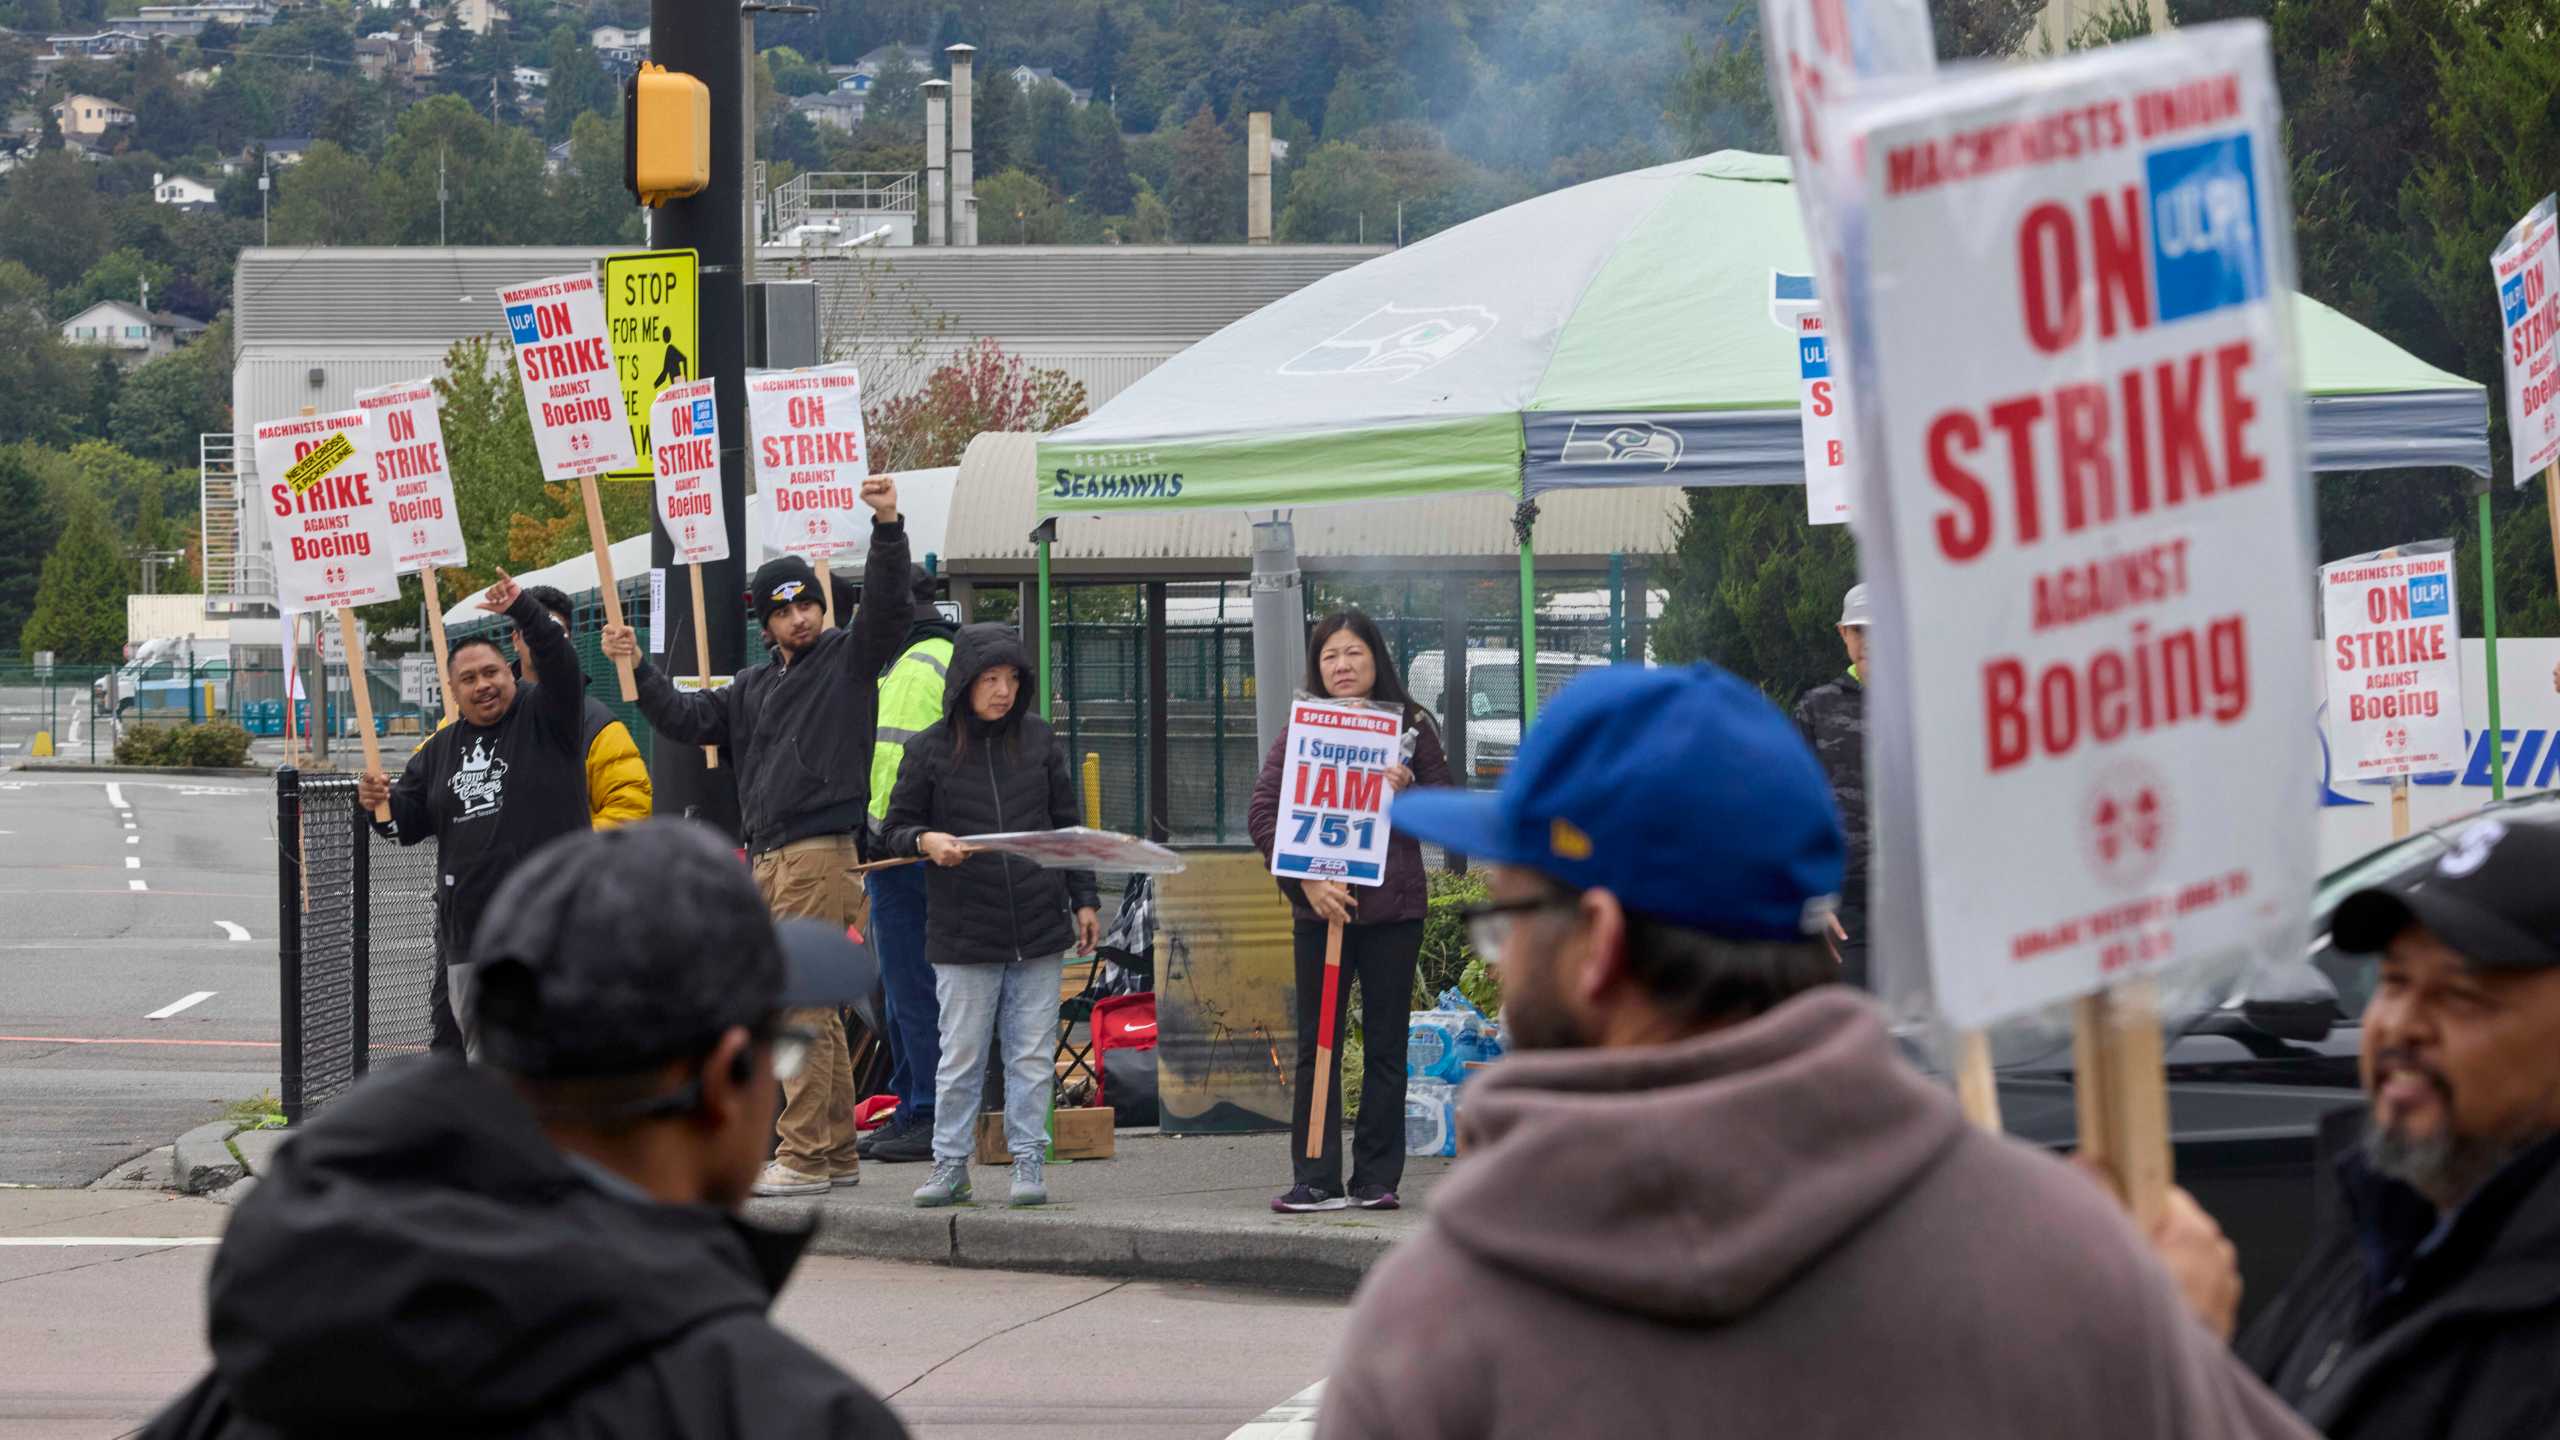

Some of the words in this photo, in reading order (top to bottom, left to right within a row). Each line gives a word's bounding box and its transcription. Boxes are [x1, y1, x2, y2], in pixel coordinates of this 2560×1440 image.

[1886, 96, 2125, 196] MACHINISTS
[2133, 72, 2242, 141] UNION
[2018, 183, 2154, 358] ON
[2525, 260, 2544, 308] ON
[503, 284, 562, 303] MACHINISTS
[563, 278, 593, 293] UNION
[625, 272, 677, 306] STOP
[511, 313, 535, 330] ULP!
[536, 302, 573, 339] ON
[613, 318, 637, 344] FOR
[642, 316, 660, 342] ME
[523, 337, 609, 382] STRIKE
[614, 355, 639, 381] T'S
[549, 380, 590, 399] AGAINST
[821, 375, 855, 388] UNION
[2523, 365, 2560, 417] Boein
[259, 421, 325, 439] MACHINISTS
[327, 415, 363, 430] UNION
[387, 409, 415, 442] ON
[542, 396, 612, 428] Boeing
[672, 405, 692, 437] ON
[788, 395, 825, 428] ON
[285, 456, 315, 480] NEVER
[314, 434, 345, 459] CROSS
[376, 442, 441, 482] STRIKE
[658, 438, 714, 477] STRIKE
[762, 431, 859, 468] STRIKE
[1924, 339, 2265, 566] STRIKE
[396, 481, 428, 498] AGAINST
[790, 470, 836, 485] AGAINST
[1054, 468, 1184, 498] SEAHAWKS
[271, 472, 373, 517] STRIKE
[388, 497, 443, 524] Boeing
[668, 492, 712, 519] Boeing
[776, 485, 854, 513] Boeing
[304, 514, 349, 532] AGAINST
[290, 531, 371, 561] Boeing
[2031, 537, 2190, 634] AGAINST
[2330, 565, 2404, 585] MACHINISTS
[2407, 559, 2446, 576] UNION
[2367, 584, 2409, 624] ON
[2412, 584, 2446, 604] ULP!
[2336, 624, 2447, 671] STRIKE
[1980, 614, 2252, 776] Boeing
[2366, 670, 2419, 690] AGAINST
[1302, 711, 1338, 725] SPEEA
[1341, 716, 1391, 732] MEMBER
[2350, 689, 2439, 722] Boeing
[1298, 736, 1306, 755] I
[1311, 738, 1389, 765] Support
[1293, 761, 1387, 813] IAM
[1291, 810, 1376, 850] 751
